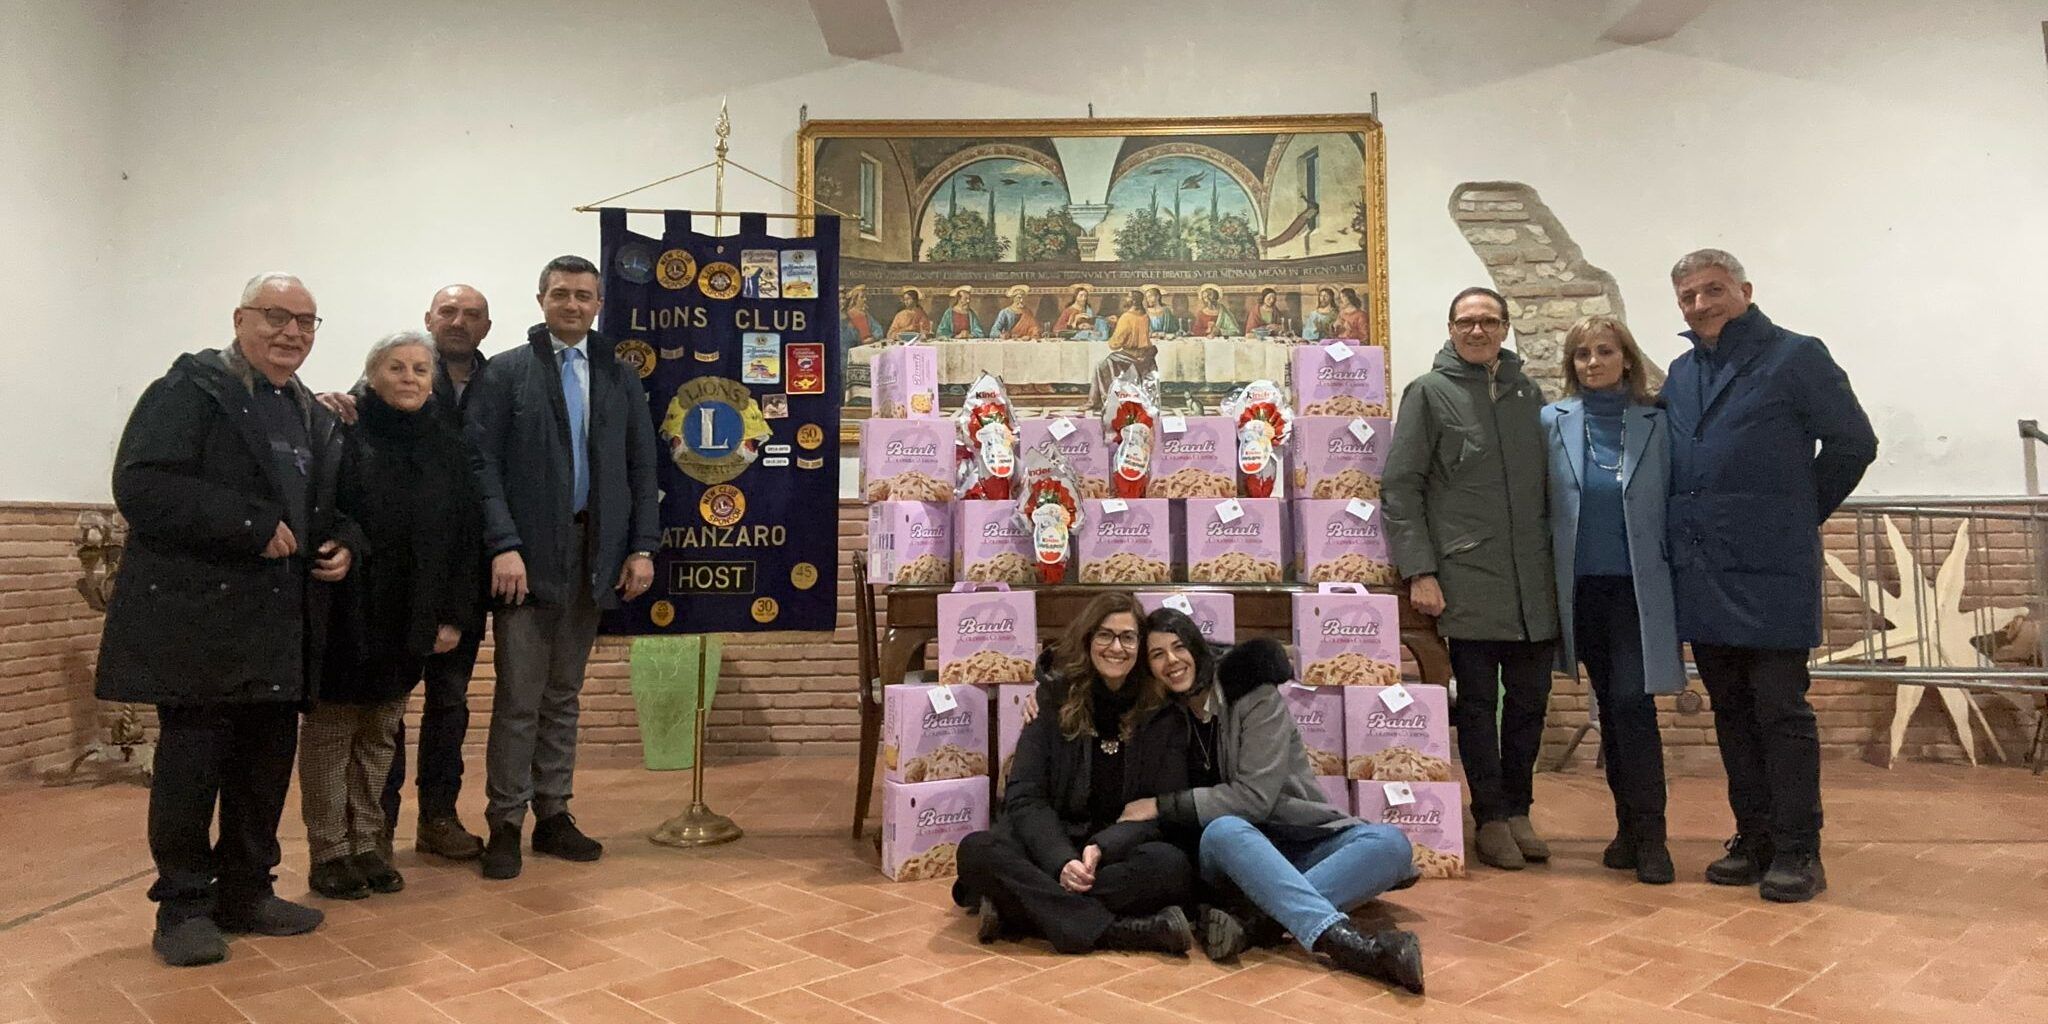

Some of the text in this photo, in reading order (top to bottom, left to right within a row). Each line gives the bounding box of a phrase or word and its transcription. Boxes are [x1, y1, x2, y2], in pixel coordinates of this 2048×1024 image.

[631, 306, 806, 331] LIONS CLUB
[1318, 366, 1368, 380] Bauli
[685, 382, 742, 403] LIONS
[699, 407, 729, 449] L
[801, 427, 817, 439] 50
[886, 440, 937, 456] Bauli
[1164, 439, 1216, 454] Bauli
[1328, 438, 1375, 454] Bauli
[1028, 467, 1051, 476] inder
[703, 486, 739, 503] NEW CLUB
[708, 508, 742, 525] SPONSOR
[660, 525, 786, 549] ATANZARO
[1097, 521, 1150, 537] Bauli
[1207, 521, 1260, 537] Bauli
[1326, 522, 1378, 537] Bauli
[678, 566, 747, 589] HOST
[796, 566, 812, 578] 45
[757, 599, 773, 612] 30
[958, 616, 1014, 634] Bauli
[1321, 618, 1379, 636] Bauli
[922, 711, 973, 729] Bauli
[1366, 711, 1427, 730] Bauli
[917, 807, 972, 827] Bauli
[1382, 806, 1440, 826] Bauli
